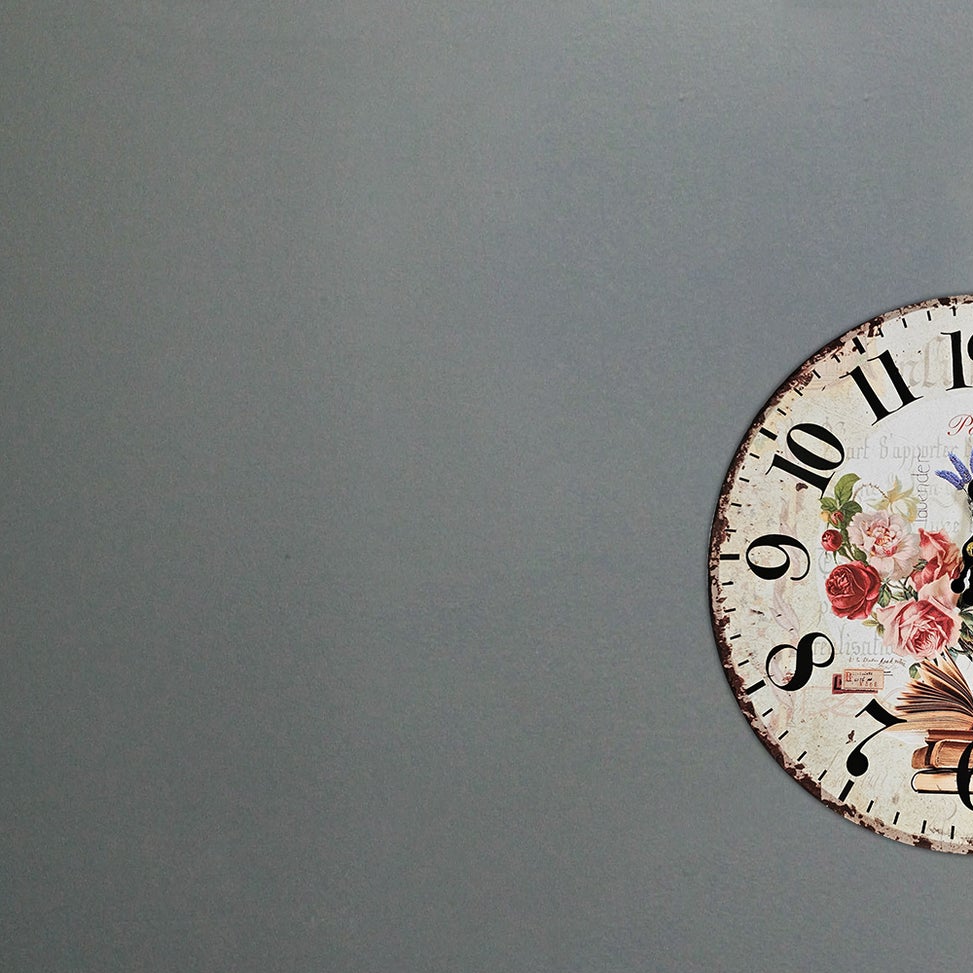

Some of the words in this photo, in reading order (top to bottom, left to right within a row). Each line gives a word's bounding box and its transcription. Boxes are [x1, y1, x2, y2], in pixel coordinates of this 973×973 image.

[839, 349, 923, 426] 11
[765, 422, 845, 499] 10
[745, 533, 811, 582] 9
[765, 632, 835, 692] 8
[846, 698, 908, 777] 7
